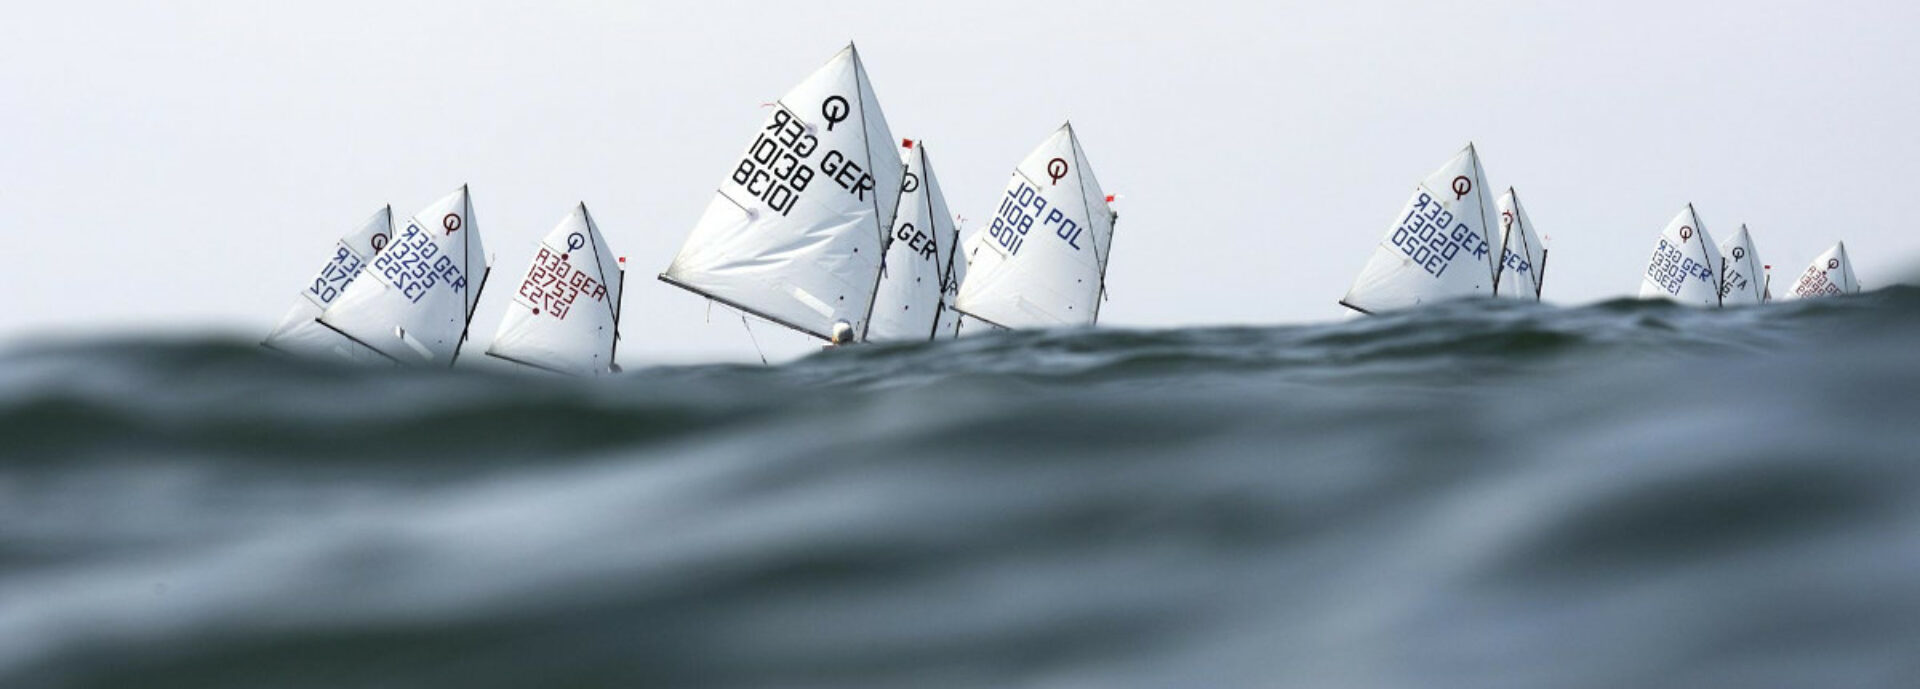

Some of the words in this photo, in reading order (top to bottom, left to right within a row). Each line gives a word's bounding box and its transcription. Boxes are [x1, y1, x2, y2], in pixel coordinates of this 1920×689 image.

[748, 132, 815, 193] 10138
[820, 150, 875, 202] GER
[998, 196, 1034, 236] 1108
[1043, 208, 1082, 251] POL
[1403, 210, 1460, 261] 13020
[897, 223, 936, 261] GER
[1451, 223, 1489, 261] GER
[388, 239, 440, 289] 13255
[433, 255, 467, 294] GER
[528, 263, 579, 305] 12753
[1681, 257, 1712, 282] GER
[570, 270, 607, 303] GER
